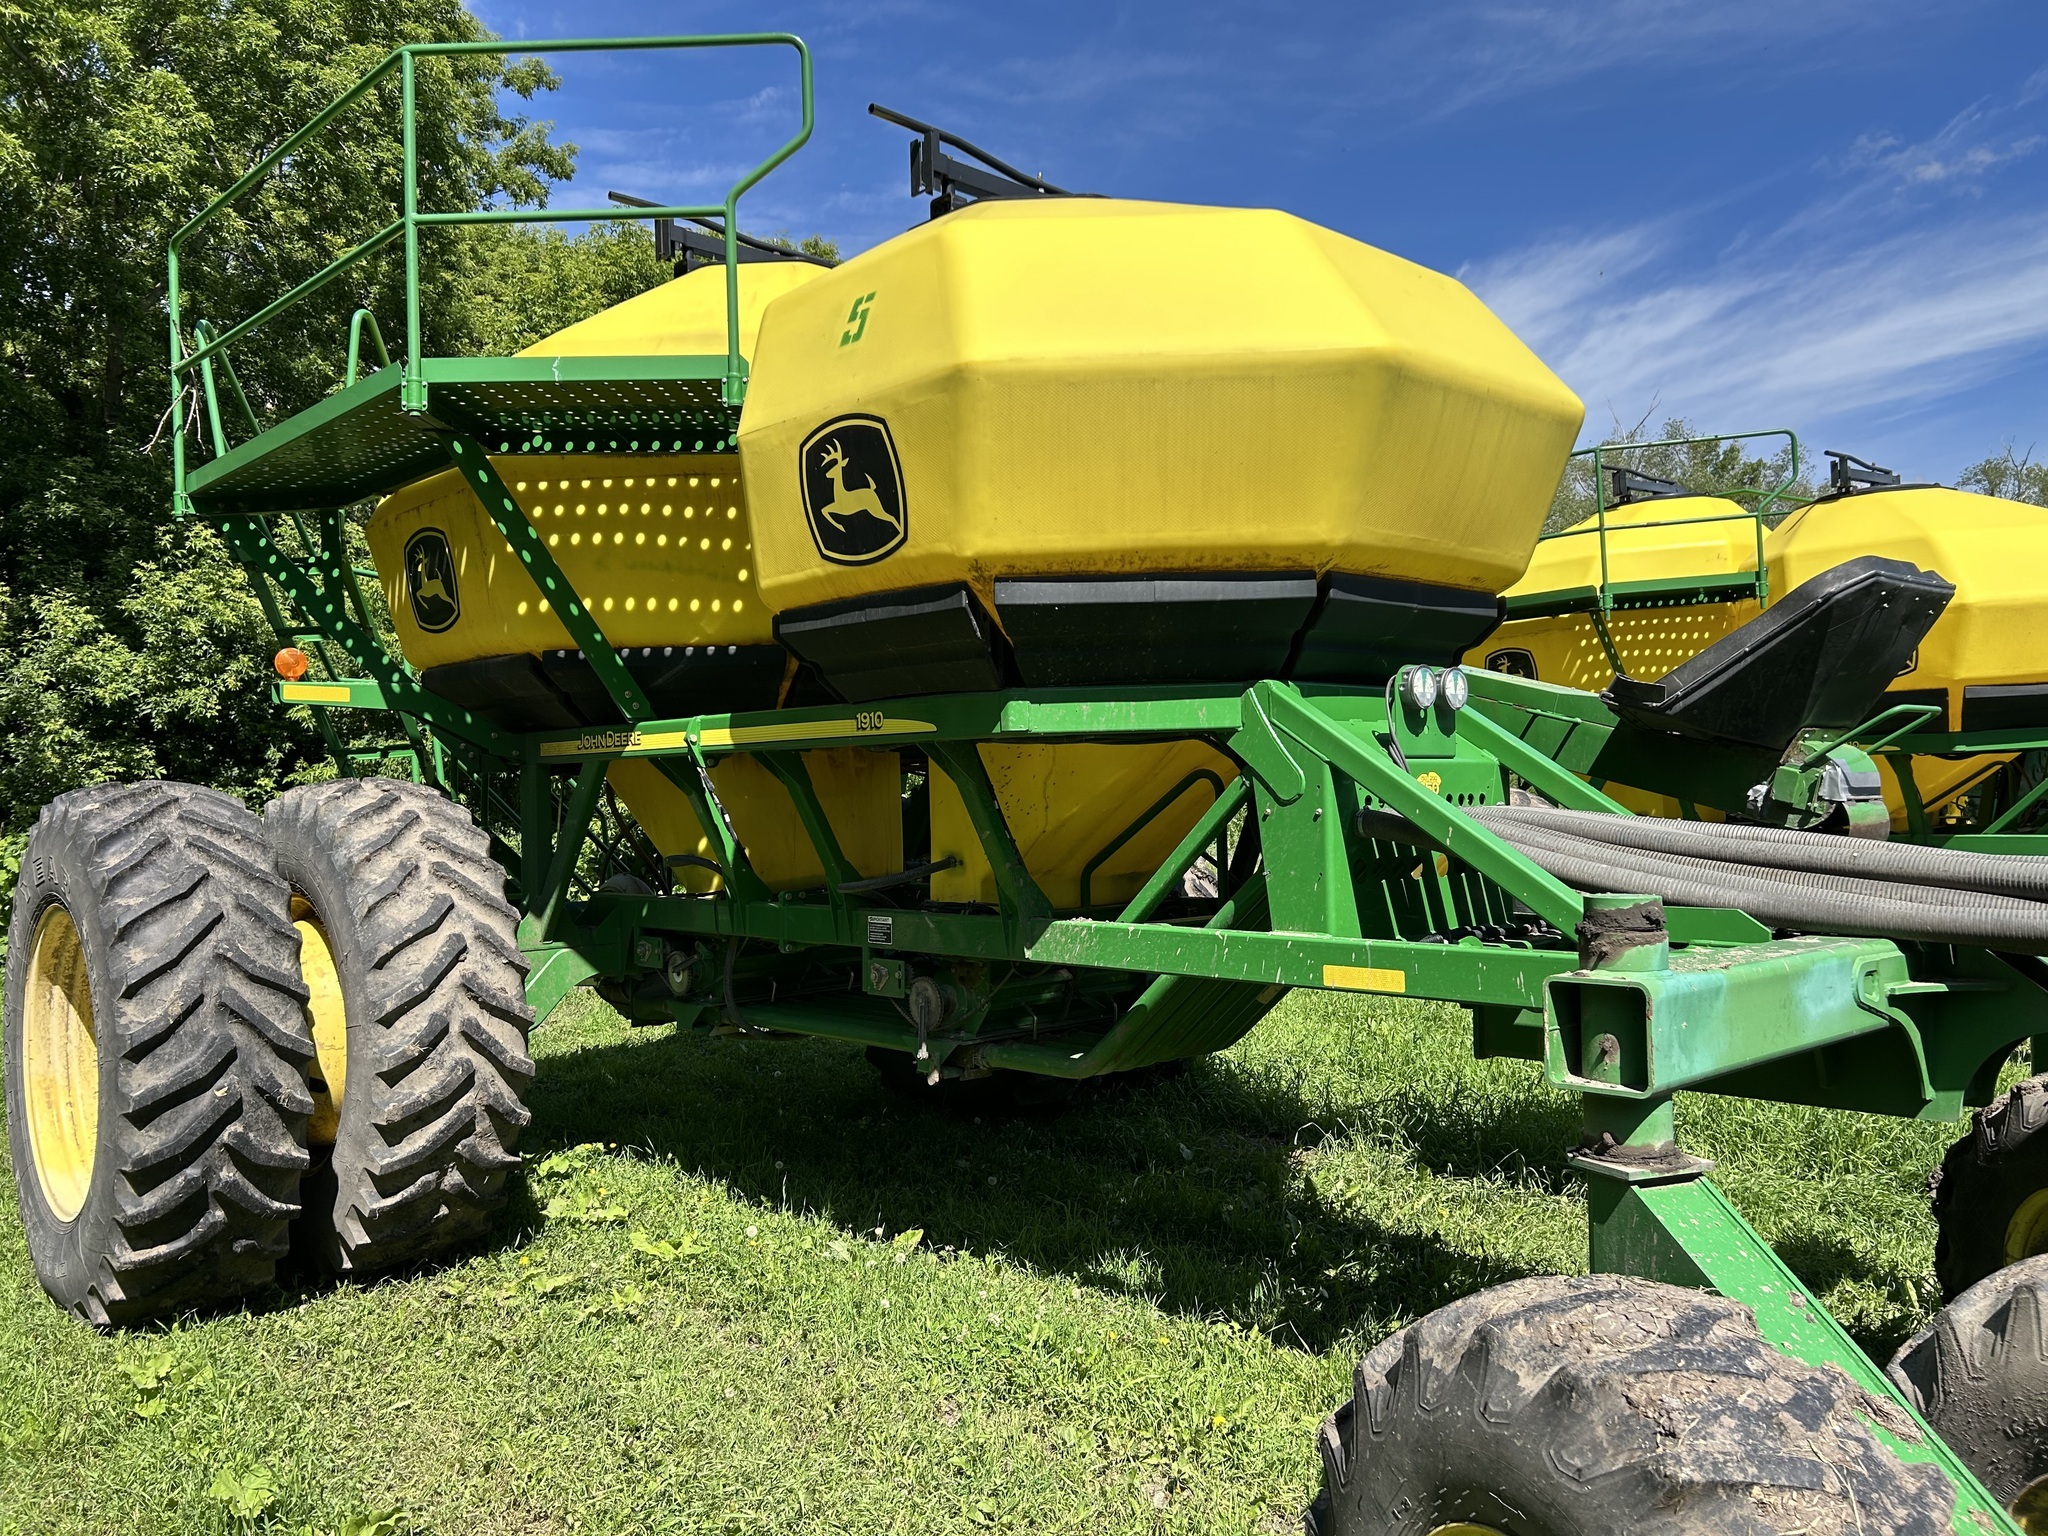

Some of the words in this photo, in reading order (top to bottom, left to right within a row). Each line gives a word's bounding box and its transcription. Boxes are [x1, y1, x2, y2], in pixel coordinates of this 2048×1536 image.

[856, 711, 884, 730] 1910
[578, 733, 606, 749] JOHN
[606, 731, 641, 747] DEERE
